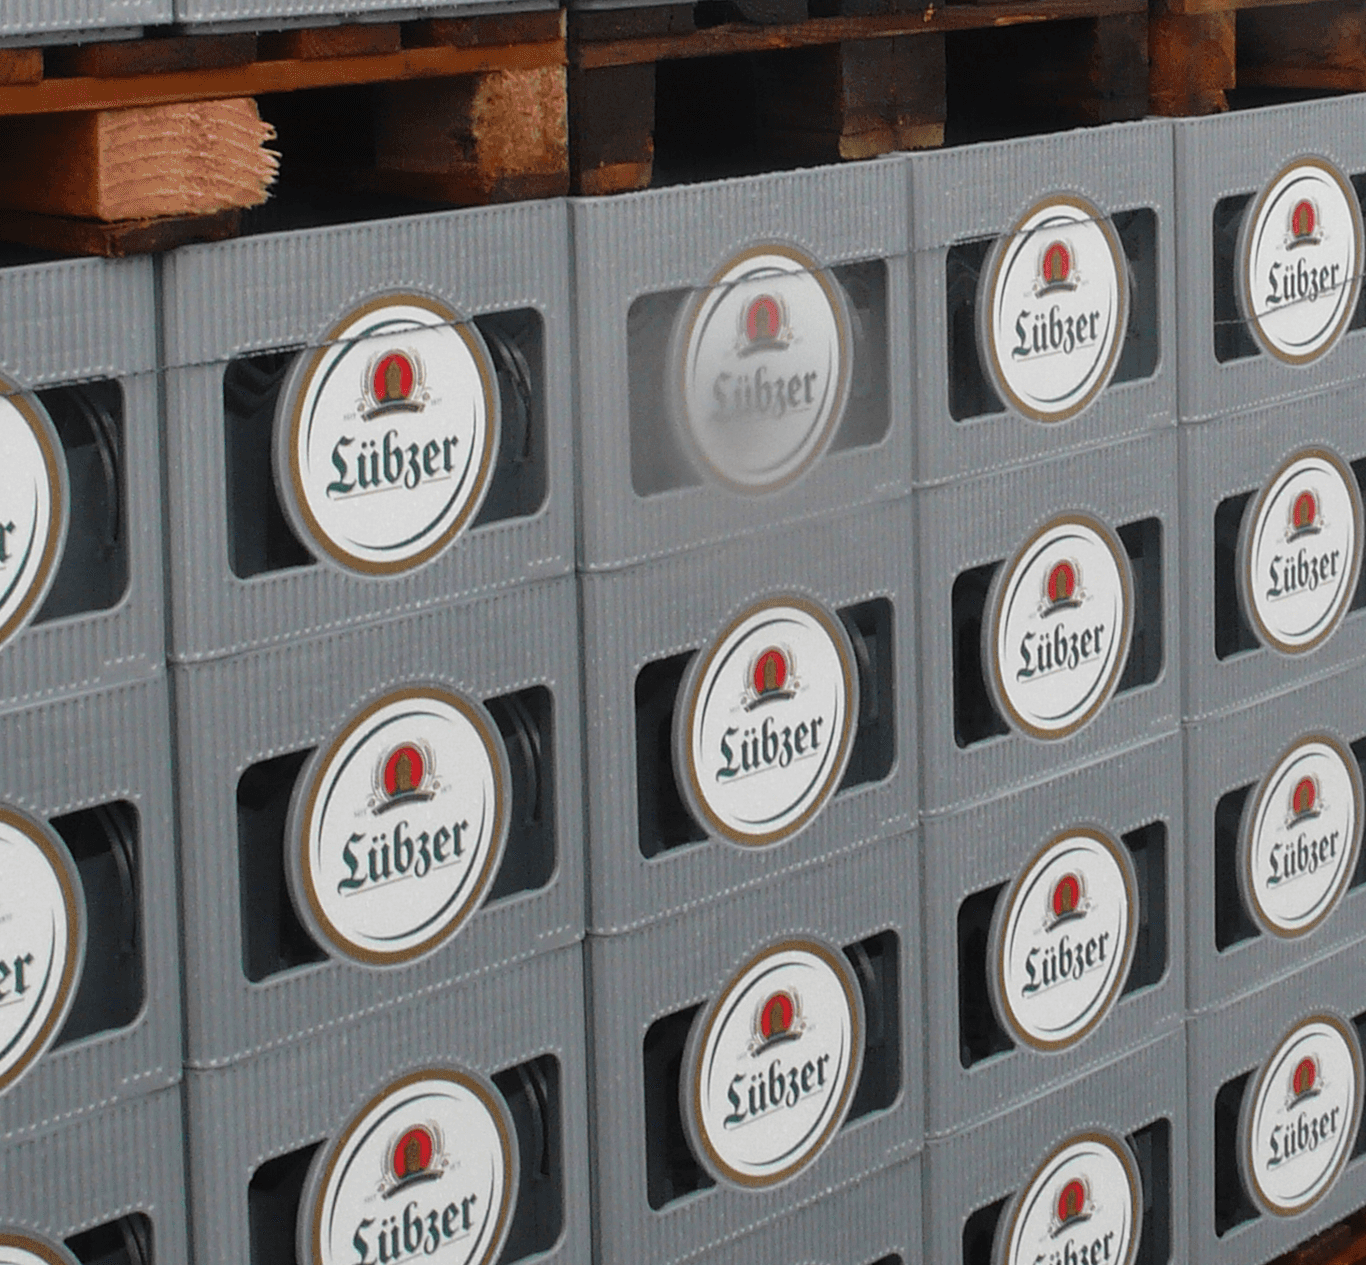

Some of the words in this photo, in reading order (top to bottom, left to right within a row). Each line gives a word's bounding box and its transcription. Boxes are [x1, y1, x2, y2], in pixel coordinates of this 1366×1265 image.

[1265, 258, 1340, 306] Lübzer
[1012, 306, 1100, 359] Lübzer
[326, 431, 458, 497] Lübzer
[1266, 549, 1340, 600] Lübzer
[1016, 624, 1105, 681] Lübzer
[716, 717, 823, 781] Lübzer
[337, 820, 468, 894] Lübzer
[1266, 831, 1339, 888] Lübzer
[1022, 932, 1109, 996] Lübzer
[723, 1054, 829, 1128] Lübzer
[1267, 1106, 1340, 1170] Lübzer
